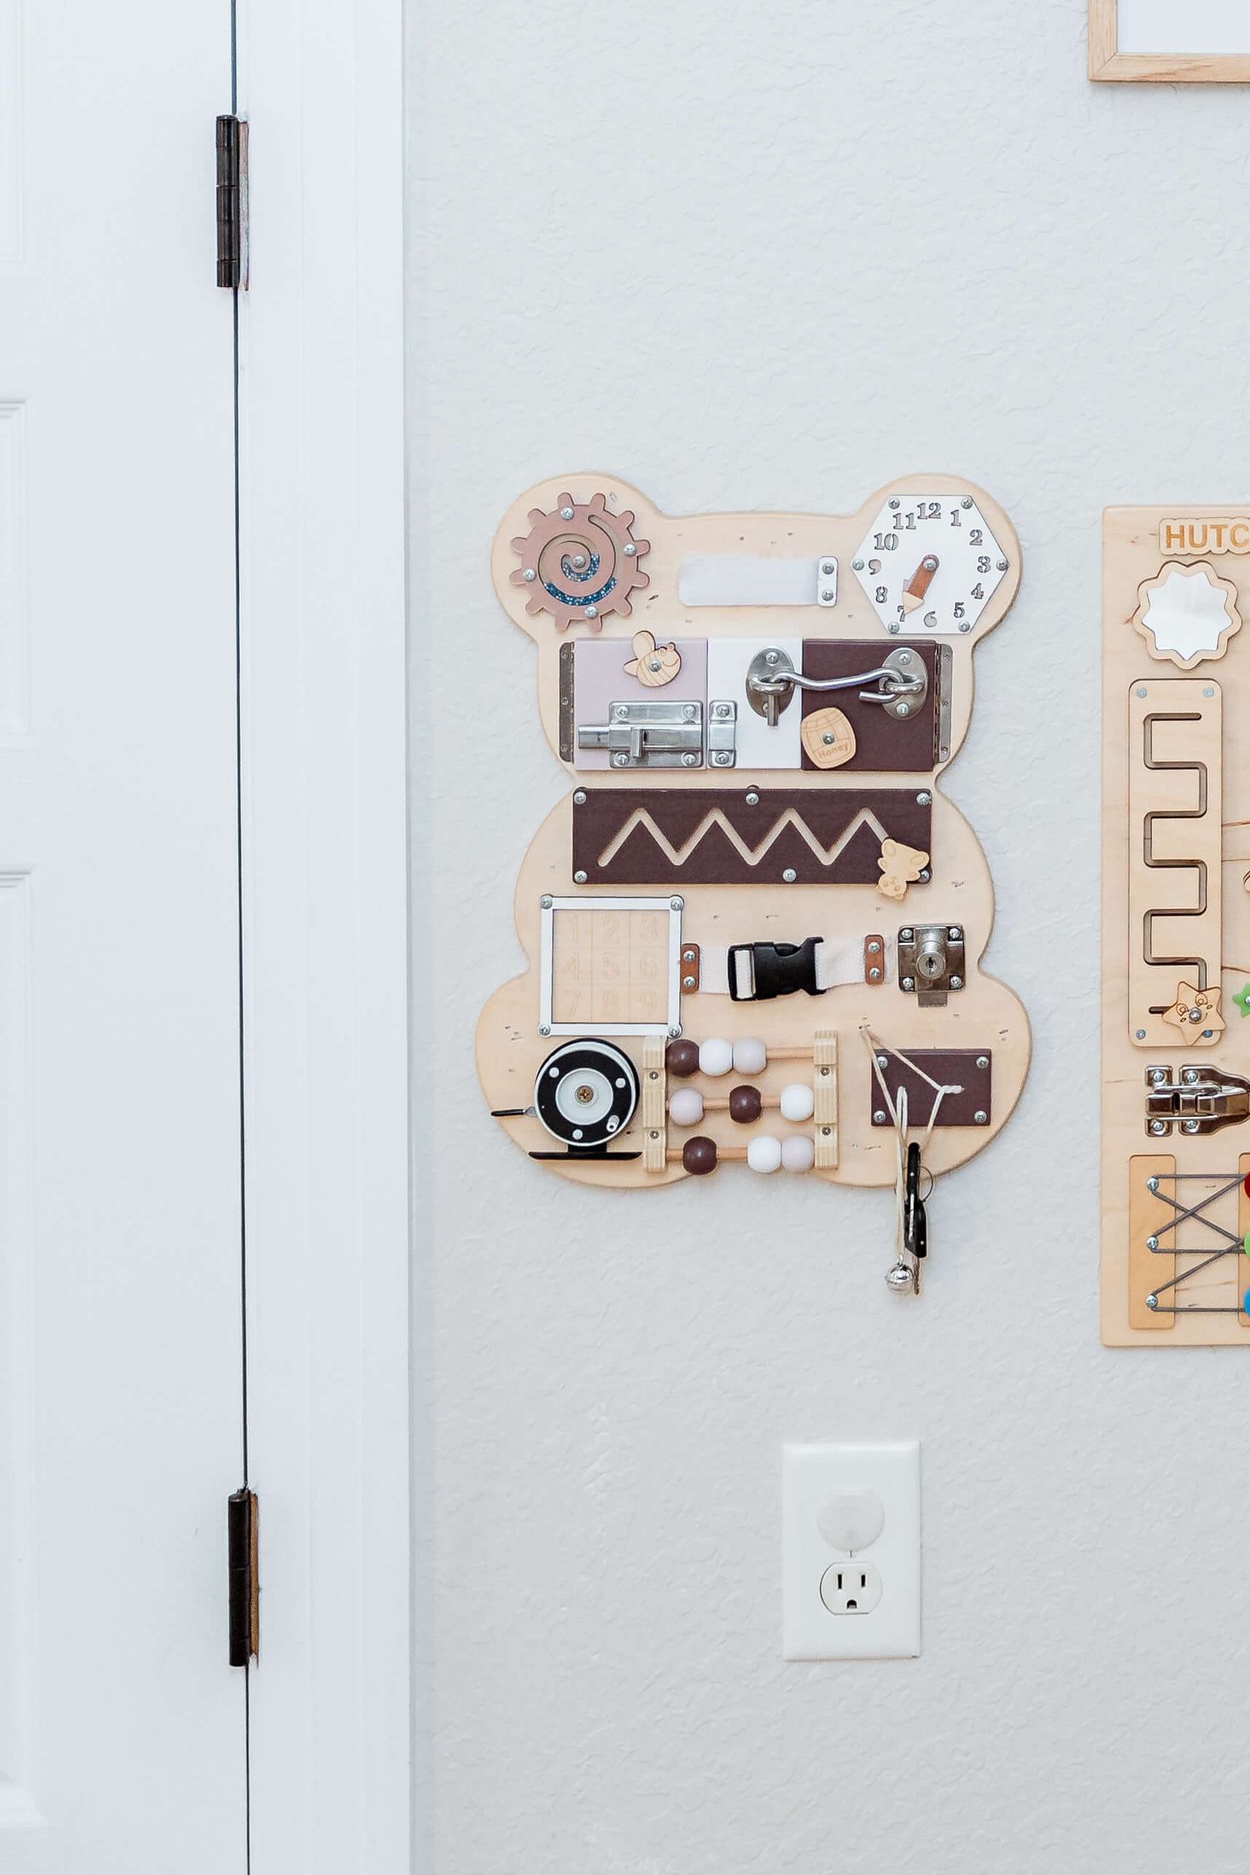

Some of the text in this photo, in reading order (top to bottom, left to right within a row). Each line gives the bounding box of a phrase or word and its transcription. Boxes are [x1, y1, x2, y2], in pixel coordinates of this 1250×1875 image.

[917, 502, 942, 520] 12
[950, 509, 962, 527] 1
[892, 512, 917, 530] 11
[874, 533, 899, 551] 10
[969, 529, 983, 546] 2
[868, 558, 882, 575] 9
[976, 555, 991, 573] 3
[875, 585, 888, 604] 8
[970, 582, 985, 600] 4
[923, 610, 938, 628] 6
[953, 601, 966, 619] 5
[818, 742, 849, 760] Honey
